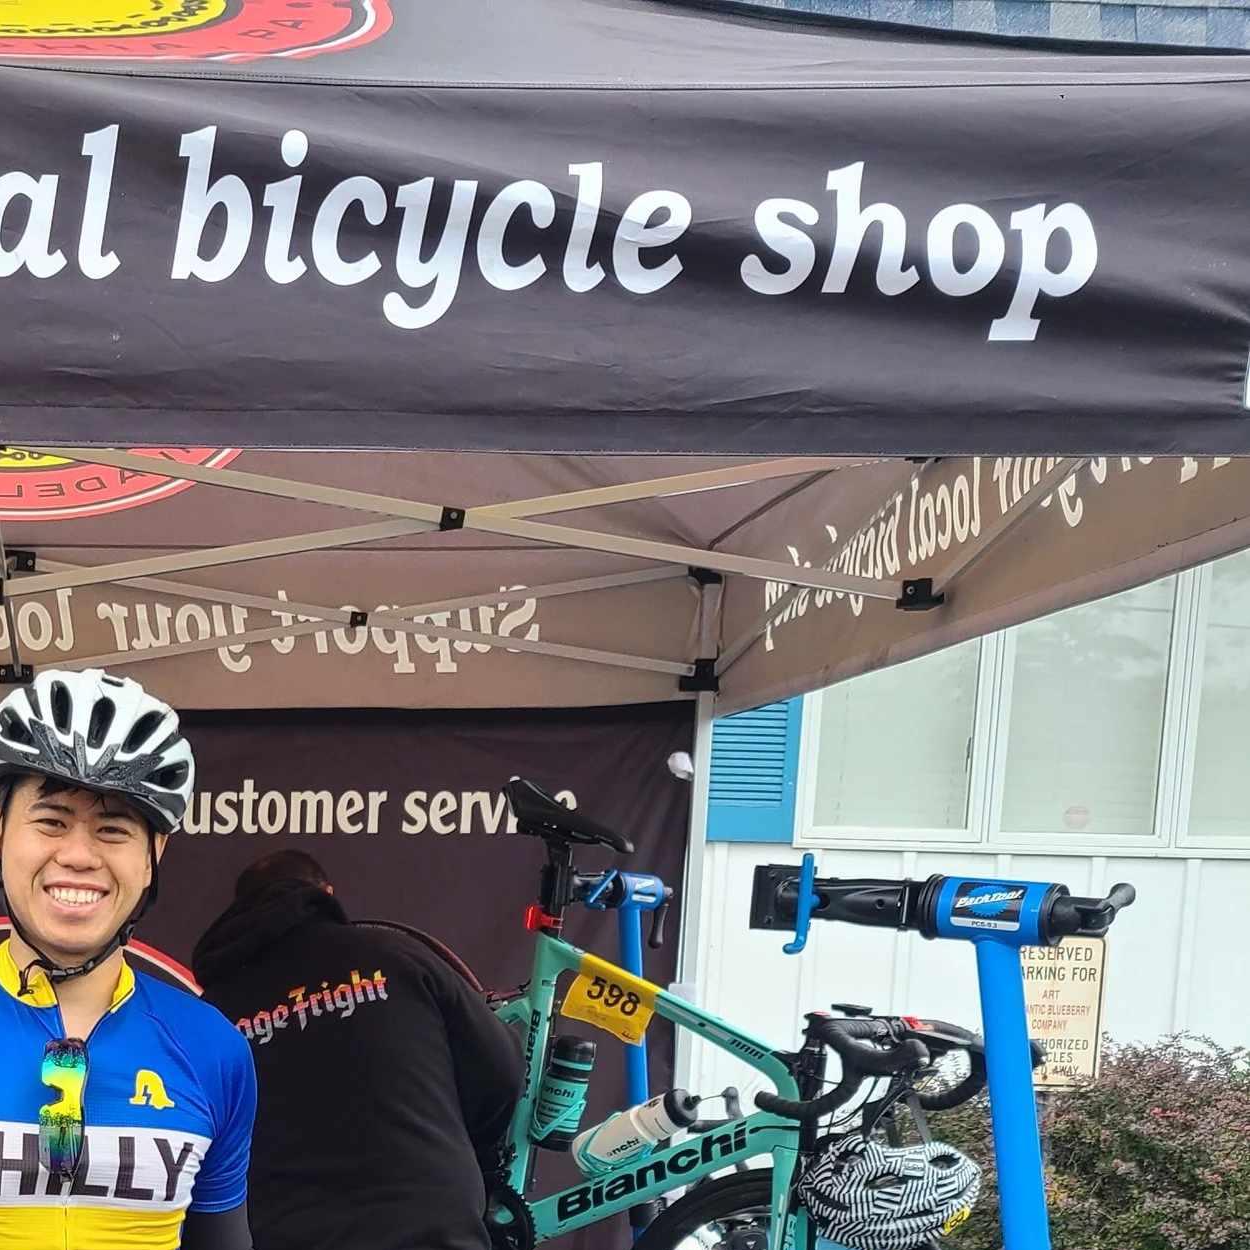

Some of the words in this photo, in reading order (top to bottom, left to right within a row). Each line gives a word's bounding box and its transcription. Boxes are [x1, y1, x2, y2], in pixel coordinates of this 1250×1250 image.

[170, 125, 692, 331] bicycle
[740, 161, 1098, 342] shop
[170, 779, 379, 836] ustomer
[1020, 946, 1093, 961] RESERVED
[1072, 967, 1097, 982] FOR
[586, 975, 641, 1017] 598
[1041, 990, 1060, 1000] ART
[1047, 1004, 1091, 1016] BLUEBERRY
[1031, 1019, 1068, 1031] COMPANY
[523, 1009, 542, 1100] Bianchi
[557, 1120, 749, 1224] Bianchi
